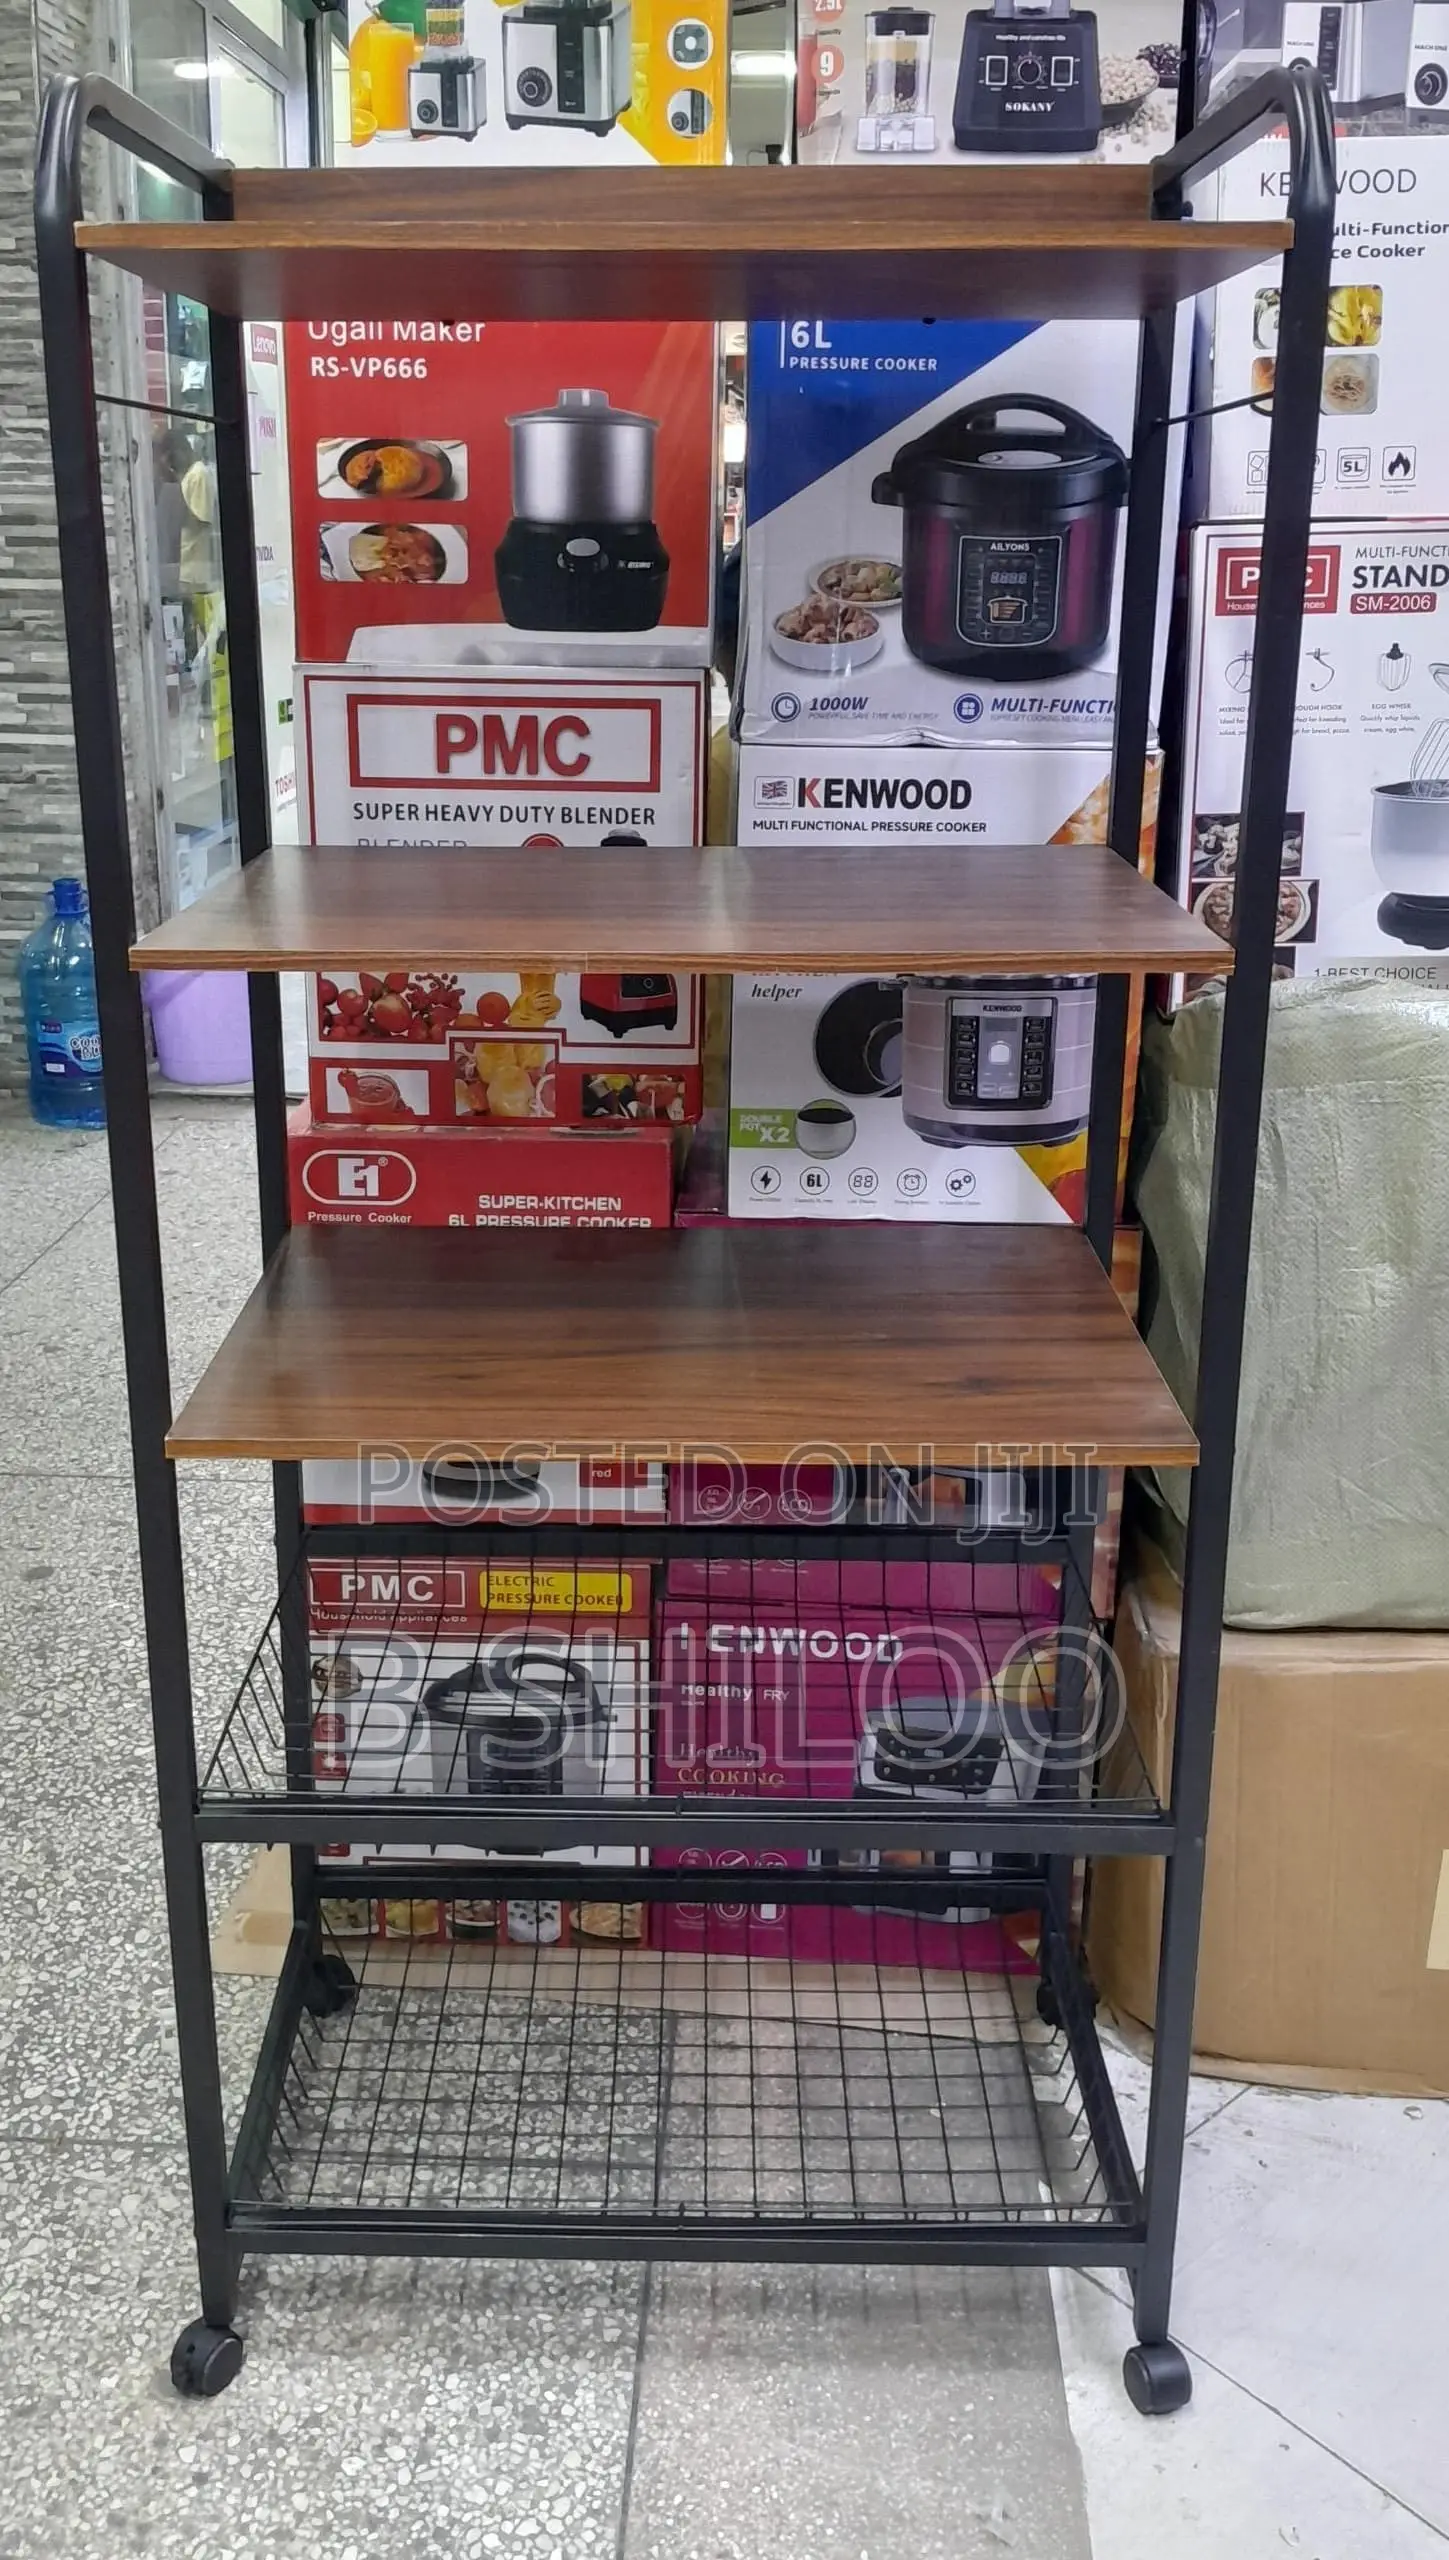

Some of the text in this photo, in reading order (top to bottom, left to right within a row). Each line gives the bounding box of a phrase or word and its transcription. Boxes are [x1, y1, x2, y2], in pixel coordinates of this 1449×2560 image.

[820, 51, 834, 76] 9
[1005, 101, 1055, 112] SOKANY
[1357, 244, 1426, 259] Cooker
[393, 321, 486, 344] Maker
[791, 320, 832, 350] 6L
[310, 356, 428, 379] RS-VP666
[789, 356, 938, 372] PRESSURE COOKER
[1355, 595, 1432, 612] SM-2006
[809, 697, 869, 712] 1000W
[436, 713, 591, 777] PMC
[797, 777, 972, 811] KENWOOD
[353, 802, 656, 826] SUPER HEAVY DUTY BLENDER
[752, 820, 987, 833] MULTI FUNCTIONAL PRESSURE COOKER
[1374, 966, 1437, 980] CHOICE
[751, 983, 803, 1002] helper
[760, 1126, 790, 1143] X2
[806, 1174, 822, 1188] 6L
[307, 1211, 412, 1224] Pressure Cooker
[448, 1214, 470, 1227] 6L
[341, 1574, 434, 1602] PMC
[488, 1575, 555, 1588] ELECTRIC
[488, 1593, 561, 1605] PRESSURE
[763, 1690, 790, 1701] FRY
